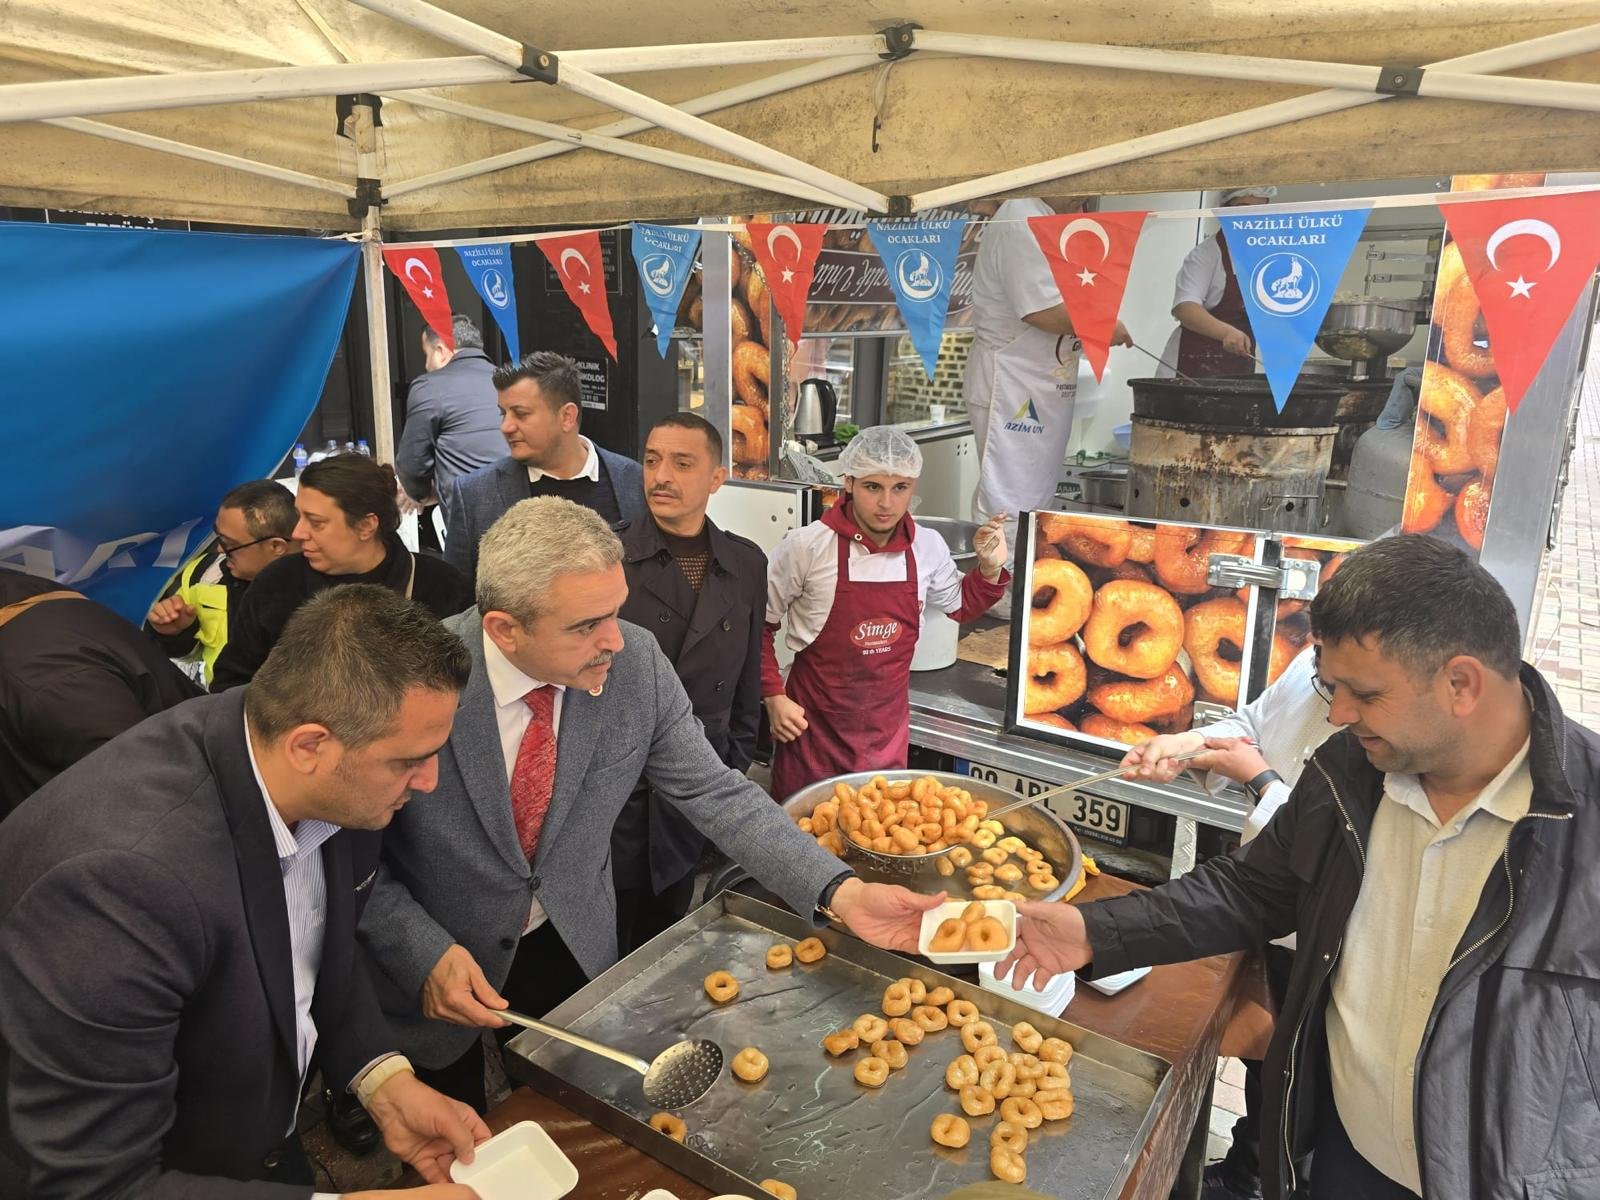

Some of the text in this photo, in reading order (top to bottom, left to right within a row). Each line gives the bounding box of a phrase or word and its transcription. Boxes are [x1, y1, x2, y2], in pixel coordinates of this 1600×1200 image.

[1232, 214, 1343, 230] NAZİLLİ ÜLKÜ
[888, 234, 941, 244] OCAKLARI
[1246, 234, 1326, 246] OCAKLARI
[471, 258, 503, 267] OCAKLARI
[854, 621, 897, 640] Simge
[1072, 795, 1121, 832] 359
